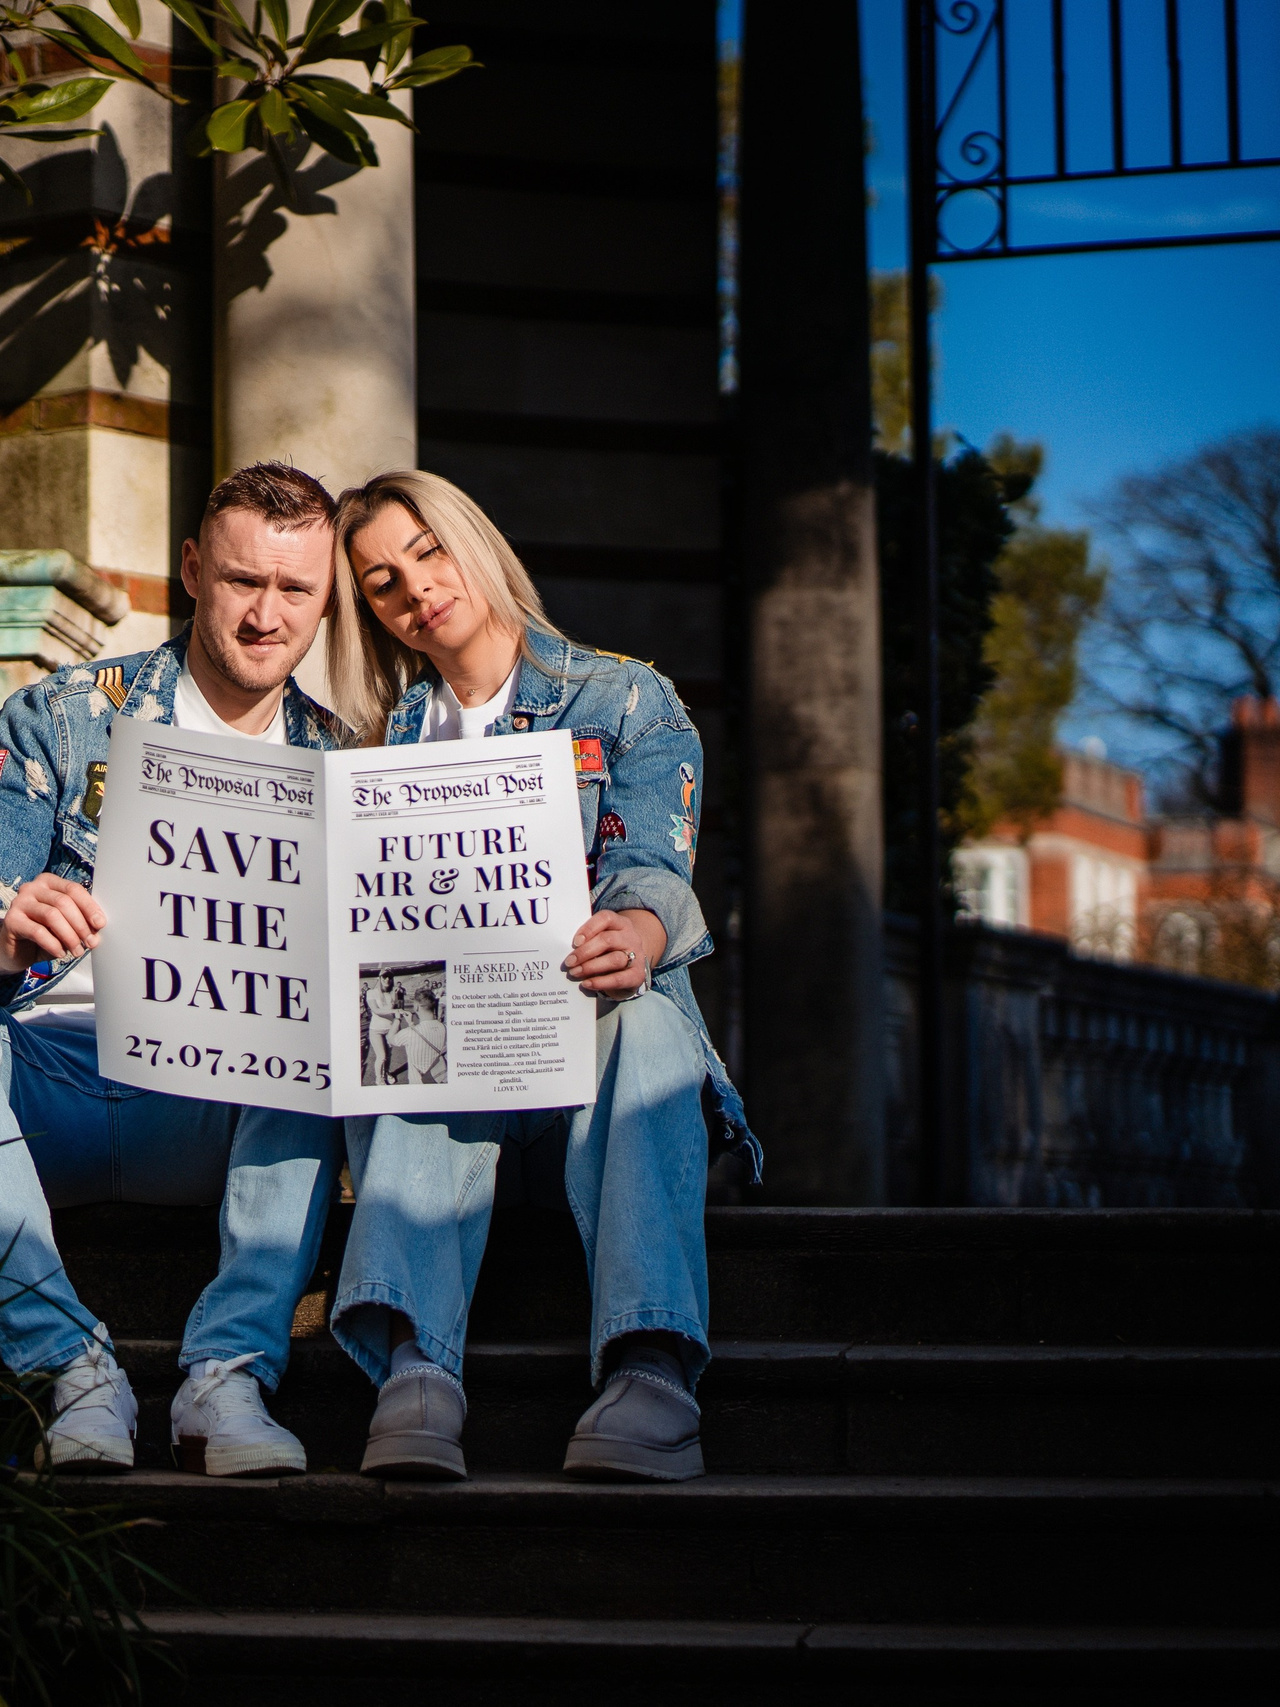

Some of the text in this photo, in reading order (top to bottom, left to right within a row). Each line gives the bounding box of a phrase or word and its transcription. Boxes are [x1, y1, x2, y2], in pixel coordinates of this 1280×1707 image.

[141, 758, 314, 805] The Proposal Post
[352, 773, 544, 810] The Proposal Post
[148, 819, 301, 885] SAVE
[378, 825, 527, 862] FUTURE
[354, 859, 552, 898] MR & MRS
[159, 891, 288, 951] THE
[348, 897, 550, 933] PASCALAU
[453, 960, 550, 974] HE ASKED, AND
[459, 970, 544, 983] SHE SAID YES
[141, 956, 310, 1022] DATE
[487, 1000, 512, 1008] stadium
[494, 1034, 502, 1042] de
[125, 1034, 332, 1091] 27.07.2025
[457, 1069, 481, 1077] poveste
[481, 1068, 489, 1076] de
